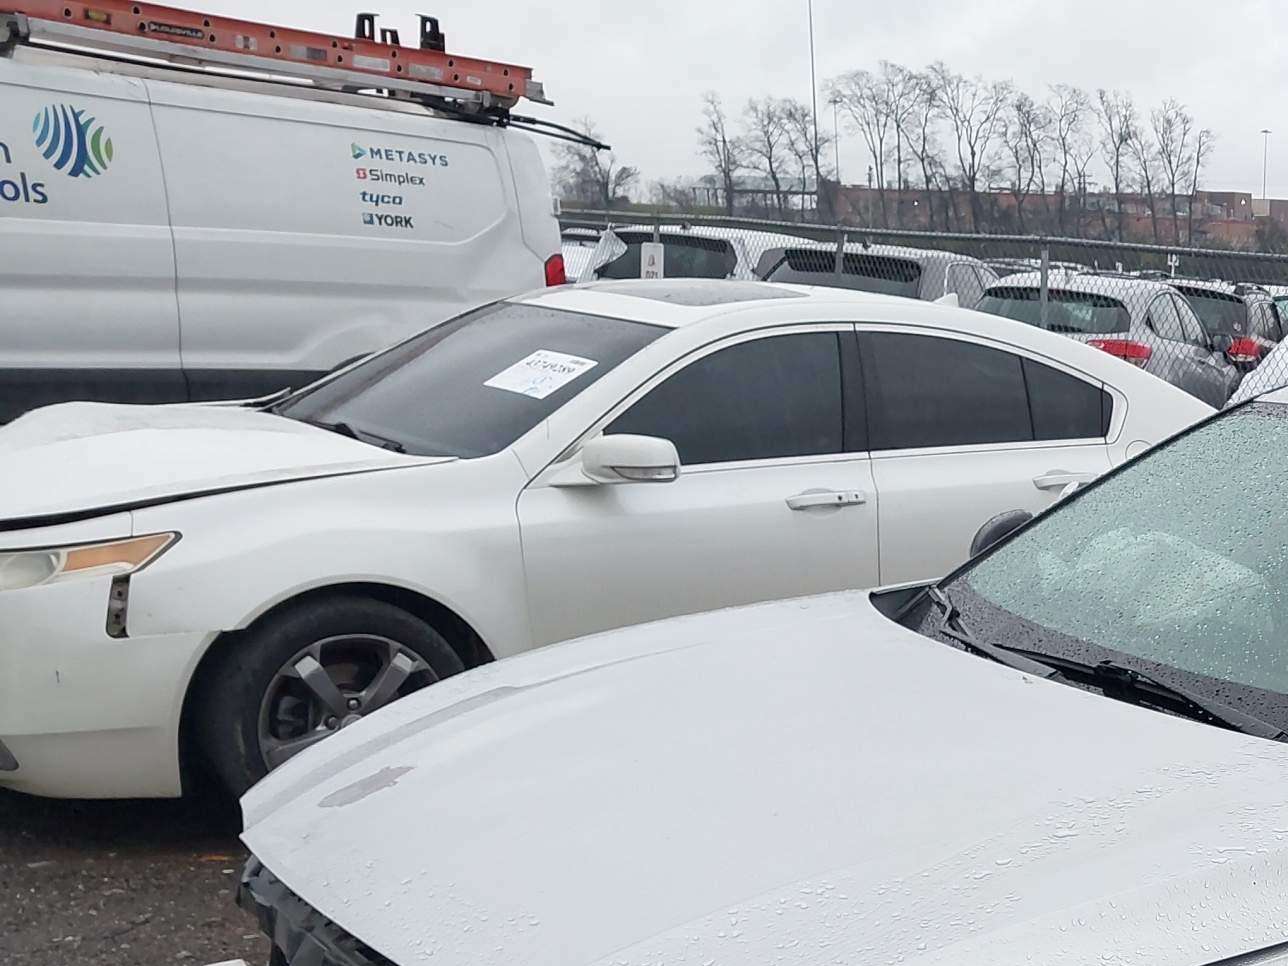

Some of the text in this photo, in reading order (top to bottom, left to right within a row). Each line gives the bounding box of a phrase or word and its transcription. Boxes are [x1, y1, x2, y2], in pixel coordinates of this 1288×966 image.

[369, 147, 449, 167] METASYS
[369, 169, 425, 186] Simplex
[360, 191, 403, 206] tyco
[375, 213, 414, 229] YORK
